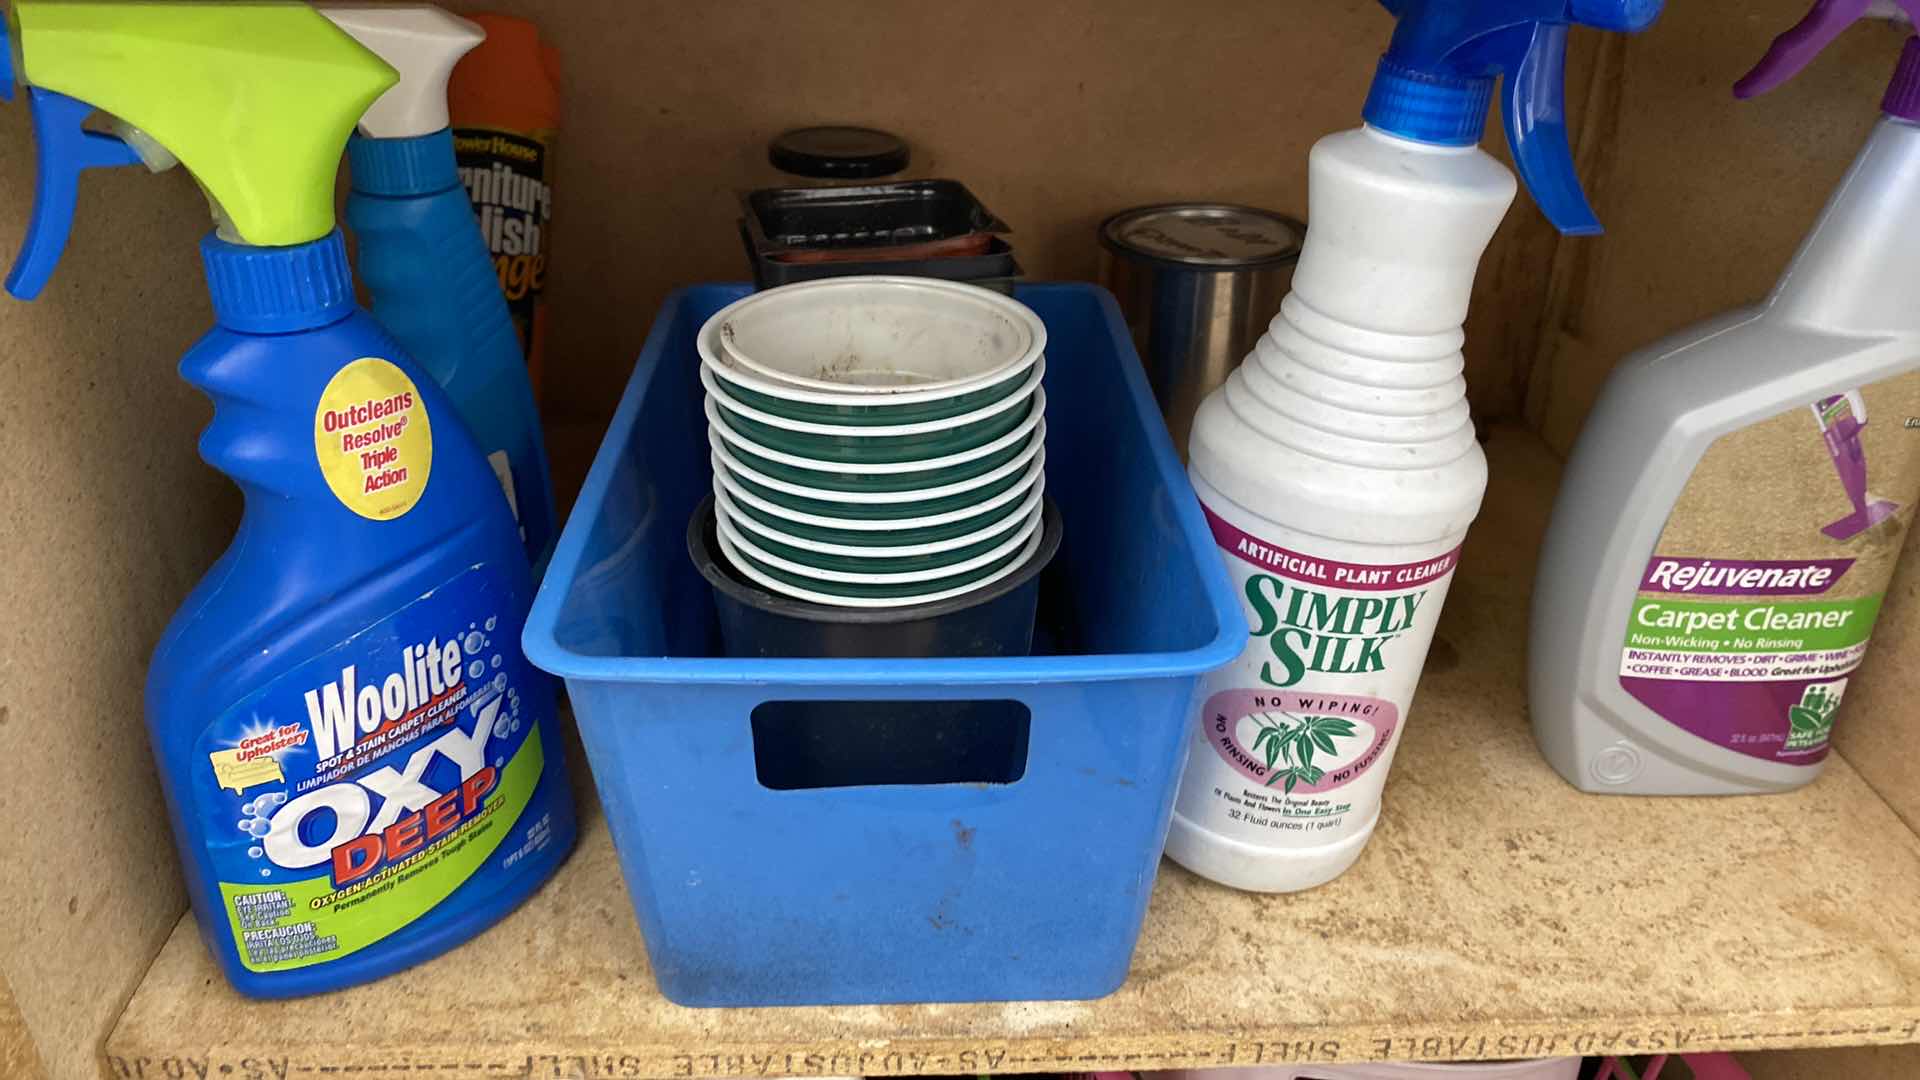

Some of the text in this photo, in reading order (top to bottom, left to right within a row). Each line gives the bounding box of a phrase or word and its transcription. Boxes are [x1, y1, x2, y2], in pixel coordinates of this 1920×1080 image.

[323, 391, 413, 432] Outcleans
[361, 446, 397, 470] Triple
[364, 467, 407, 493] Action
[1238, 538, 1451, 585] ARTIFICIAL PLANT CLEANER
[1649, 561, 1832, 591] Rejuvenate
[1244, 574, 1428, 637] SIMPLY
[1637, 604, 1852, 634] Carpet Cleaner
[1631, 633, 1803, 650] Non-Wicking No Rinsing
[1260, 628, 1393, 687] SILK
[1628, 650, 1691, 663] INSTANTLY
[1692, 654, 1746, 665] REMOVES
[1632, 664, 1768, 677] COFFEE GREASE BLOOD
[1771, 667, 1801, 676] Great
[304, 637, 463, 761] Woolite
[1255, 696, 1379, 717] NO WIPING!
[240, 722, 300, 750] Great for
[316, 686, 467, 773] SPOT & STAIN CARPET CLEANER
[1215, 713, 1265, 776] NO RINSING
[236, 731, 308, 762] Upholstery
[296, 762, 355, 792] LIMPIADOR
[357, 754, 371, 767] DE
[372, 728, 420, 759] MANCHAS
[264, 693, 503, 868] OXY
[1333, 769, 1350, 783] NO
[331, 766, 496, 885] DEEP
[1228, 808, 1242, 820] 32
[1243, 813, 1268, 827] Fluid
[1270, 820, 1303, 831] ounces
[1282, 807, 1292, 815] In
[1295, 807, 1312, 816] One
[1315, 807, 1332, 817] Easy
[310, 882, 361, 910] OXYGEN
[365, 850, 426, 888] ACTIVATED
[427, 829, 458, 856] STAIN
[234, 890, 287, 906] CAUTION:
[334, 881, 395, 912] Permanently
[1216, 1039, 1341, 1063] SHELF
